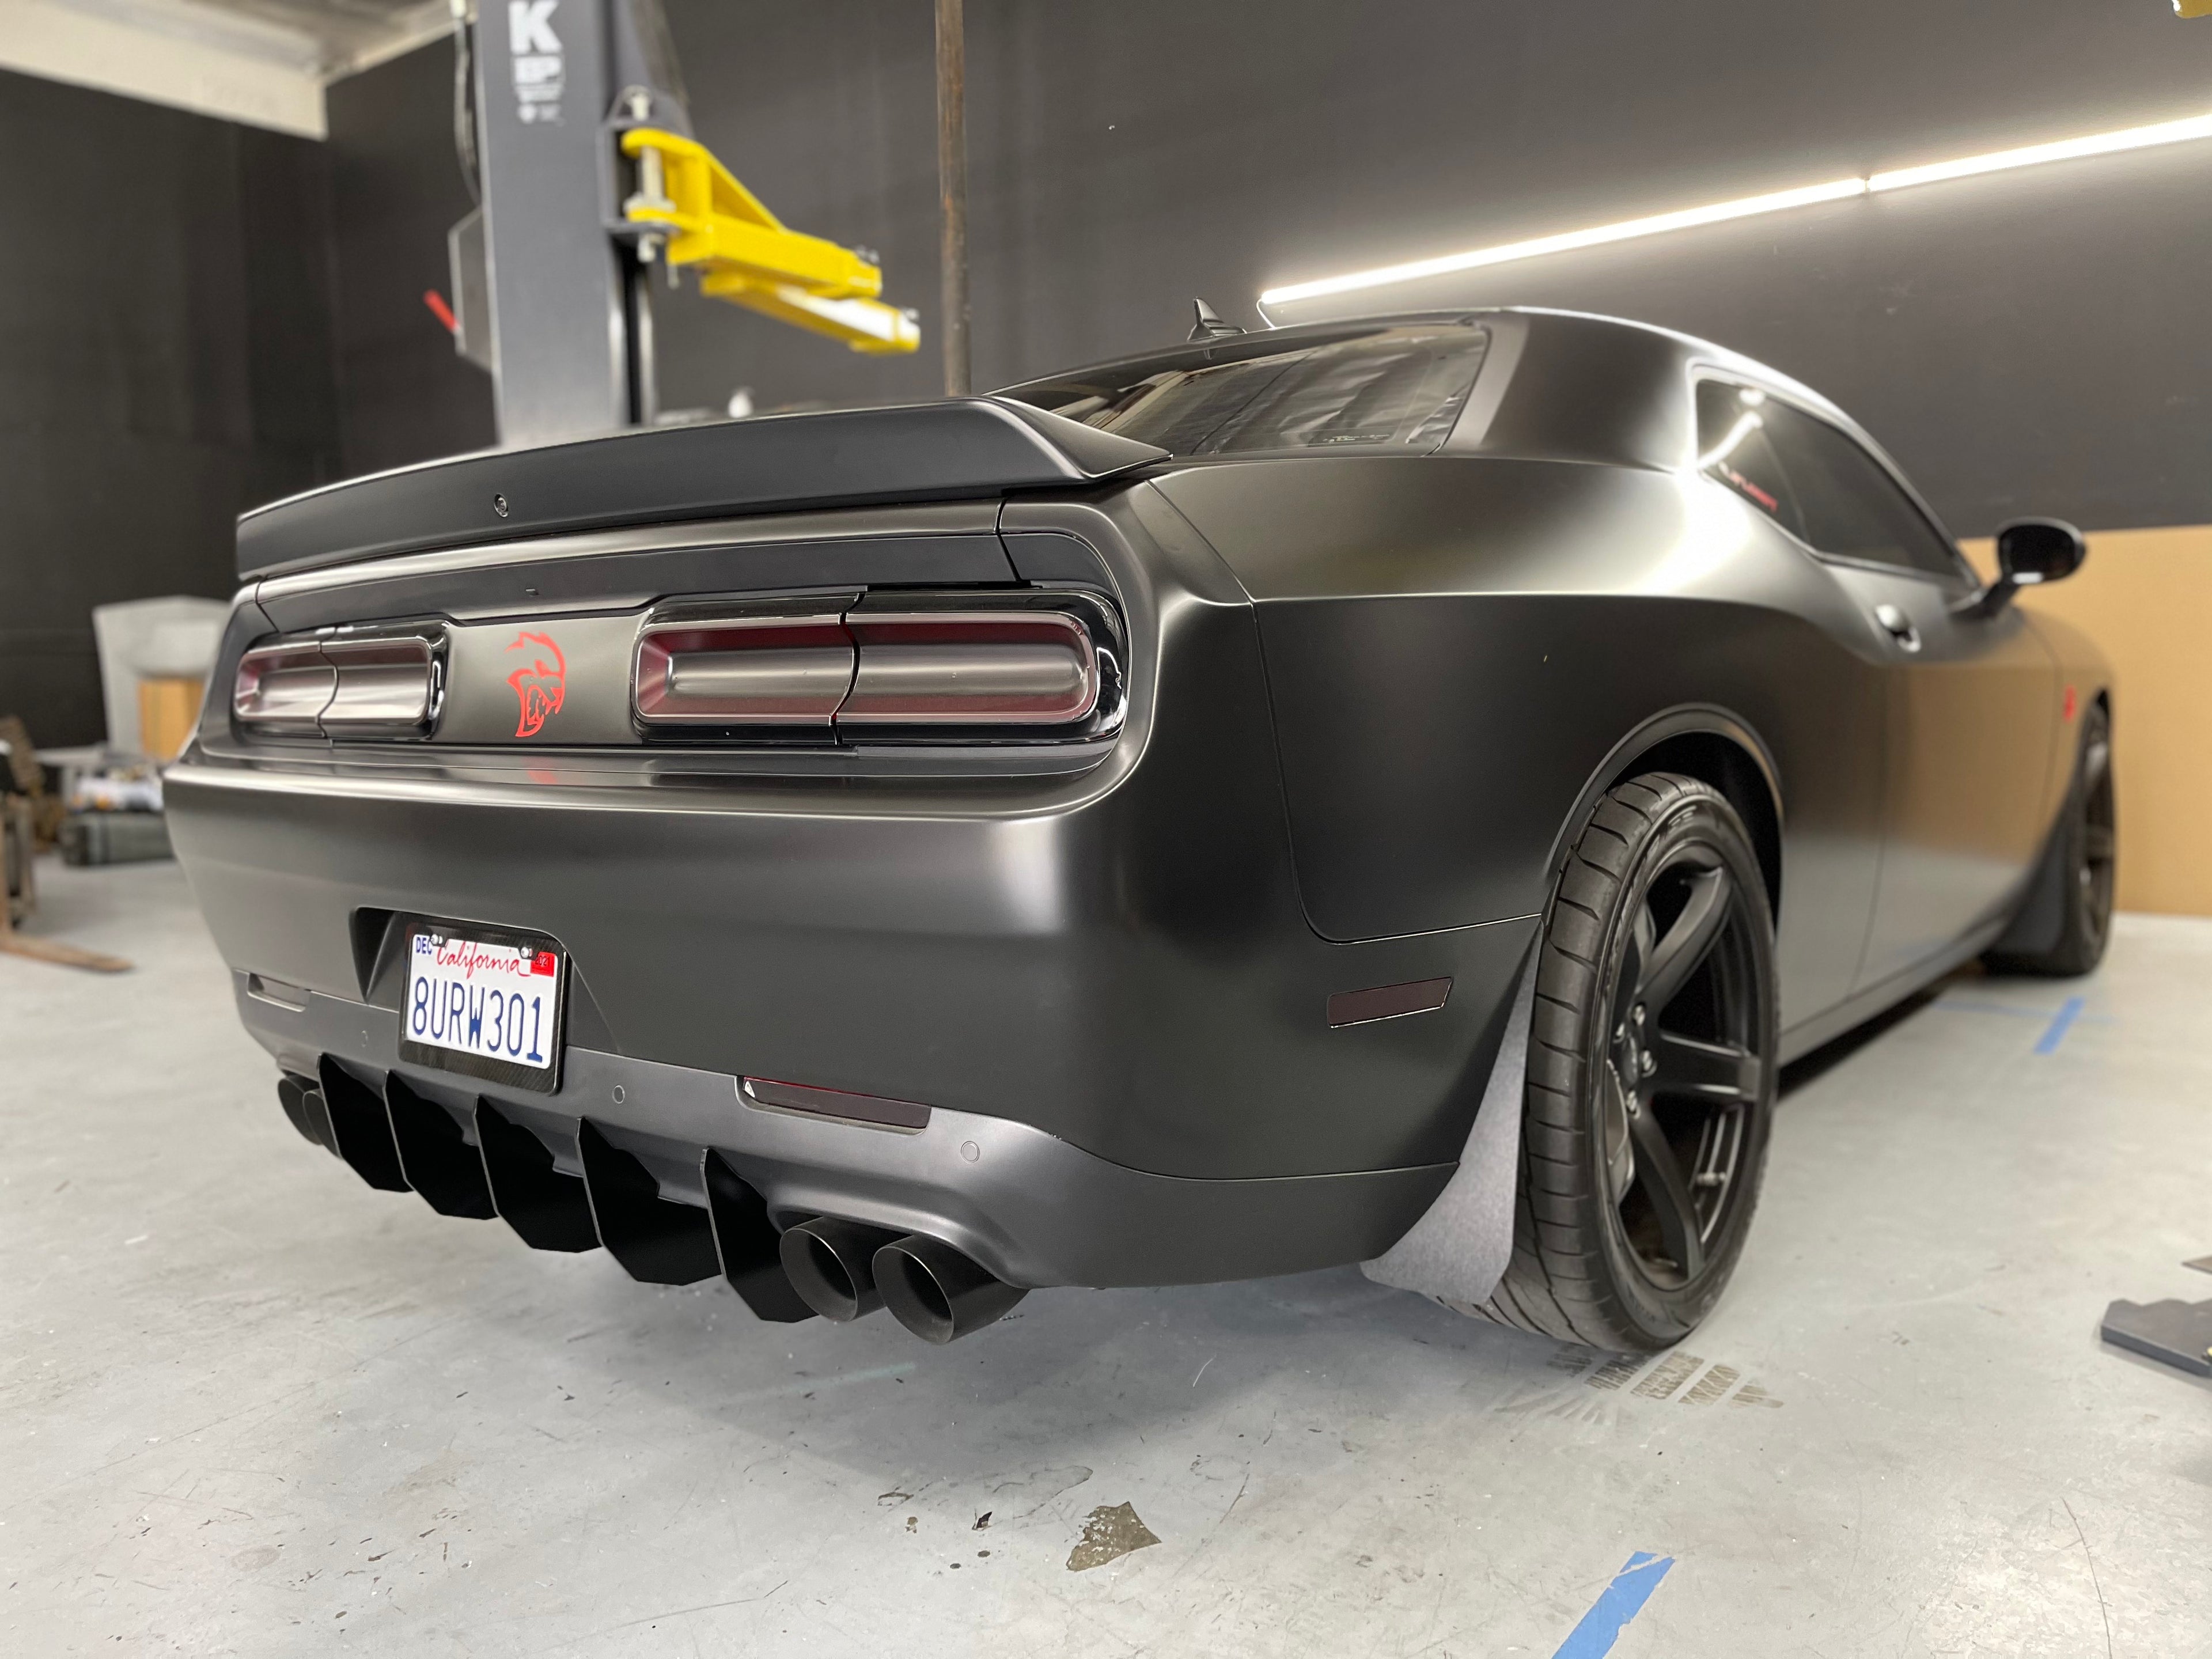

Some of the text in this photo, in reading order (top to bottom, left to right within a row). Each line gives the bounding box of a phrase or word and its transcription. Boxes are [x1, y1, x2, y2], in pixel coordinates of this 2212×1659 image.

[416, 937, 433, 955] DEC
[437, 938, 531, 979] California
[413, 976, 543, 1063] 8URW301
